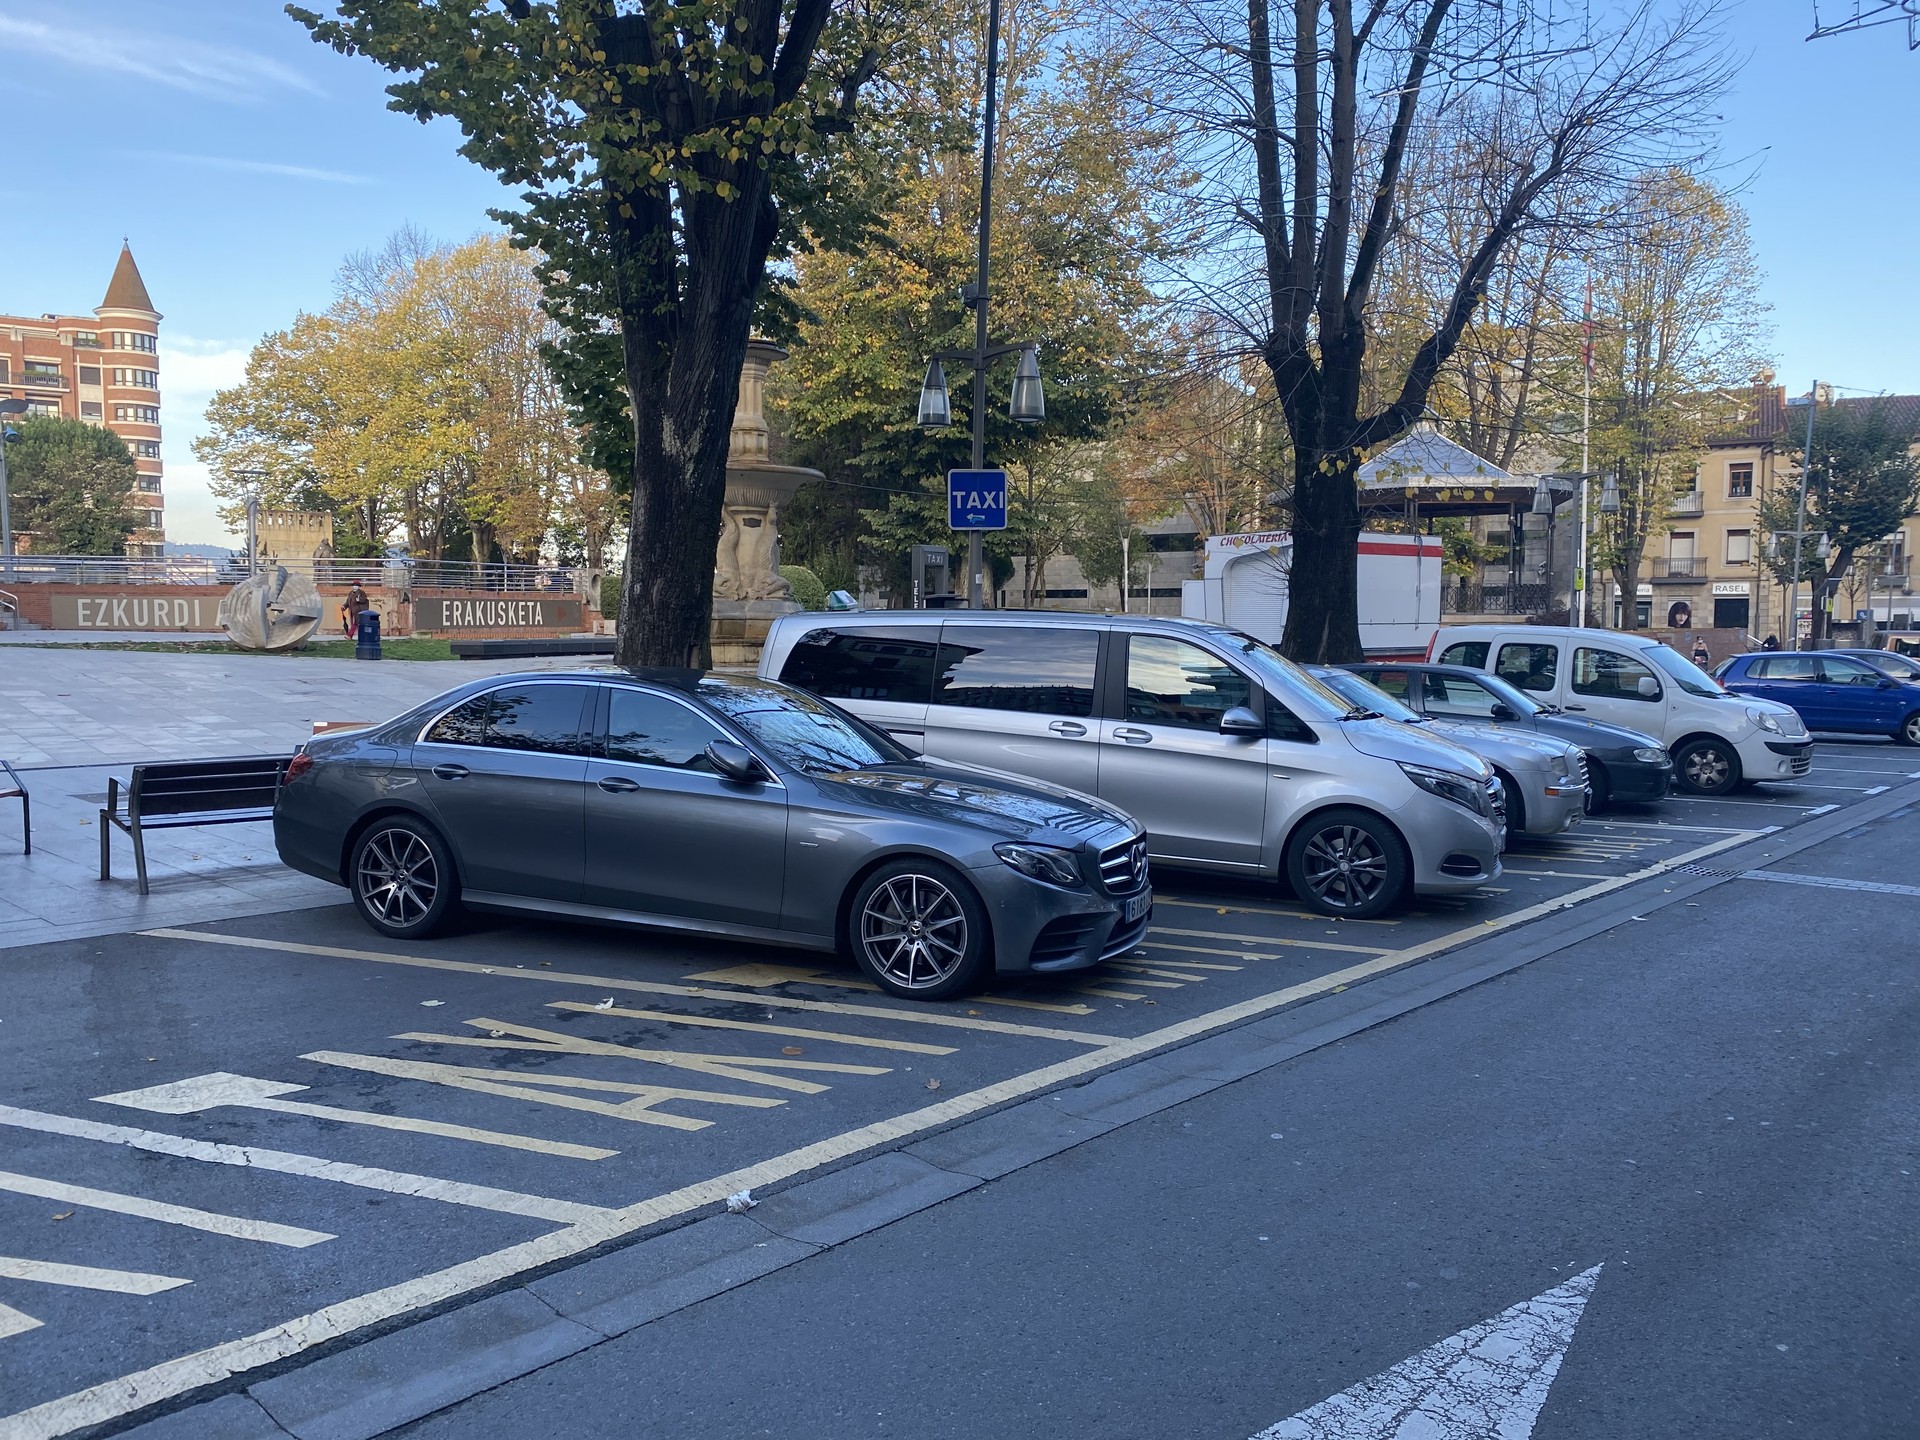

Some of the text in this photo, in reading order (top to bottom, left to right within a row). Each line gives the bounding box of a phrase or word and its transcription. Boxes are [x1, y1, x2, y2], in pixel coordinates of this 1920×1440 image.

[952, 491, 1004, 509] TAXI
[927, 554, 944, 564] TAXI
[77, 599, 200, 627] EZKURDI
[442, 600, 543, 626] ERAKUSKETA
[90, 1001, 960, 1161] TAXI
